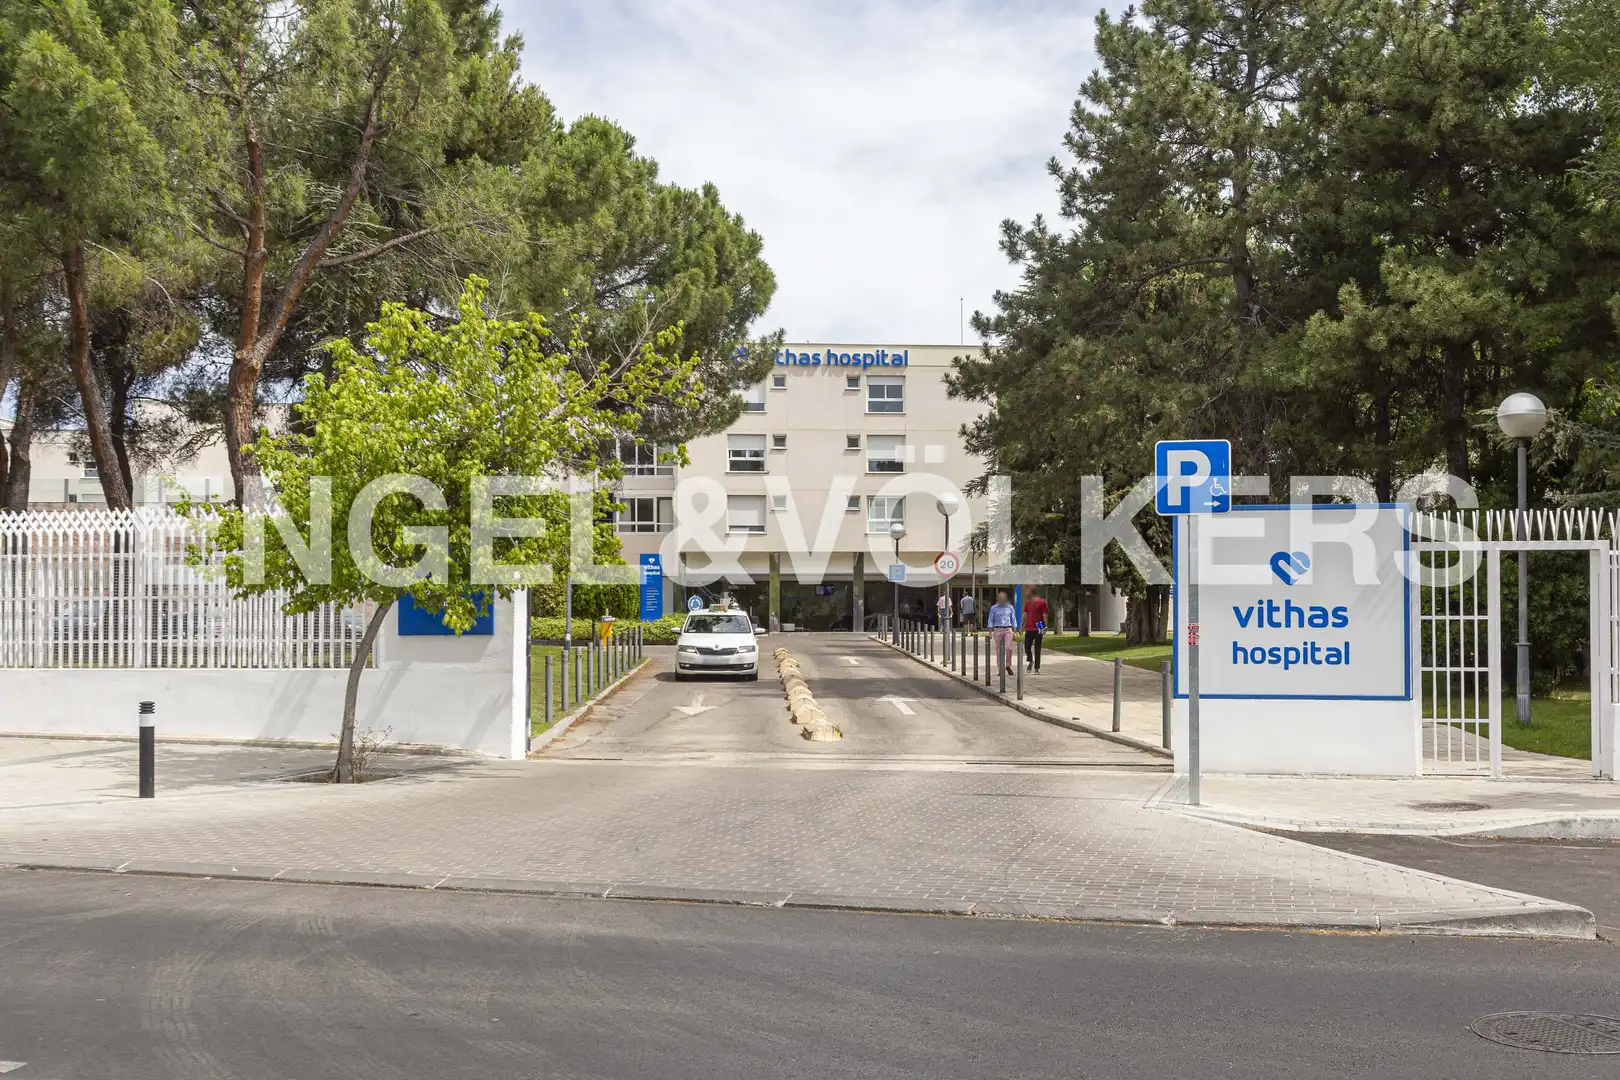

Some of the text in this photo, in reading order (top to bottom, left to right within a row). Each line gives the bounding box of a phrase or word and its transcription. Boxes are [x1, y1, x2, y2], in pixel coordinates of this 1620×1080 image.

[775, 348, 909, 371] thas hospital
[1167, 449, 1212, 506] P
[939, 560, 954, 569] 20
[1232, 599, 1350, 629] vithas
[1232, 641, 1350, 671] hospital
